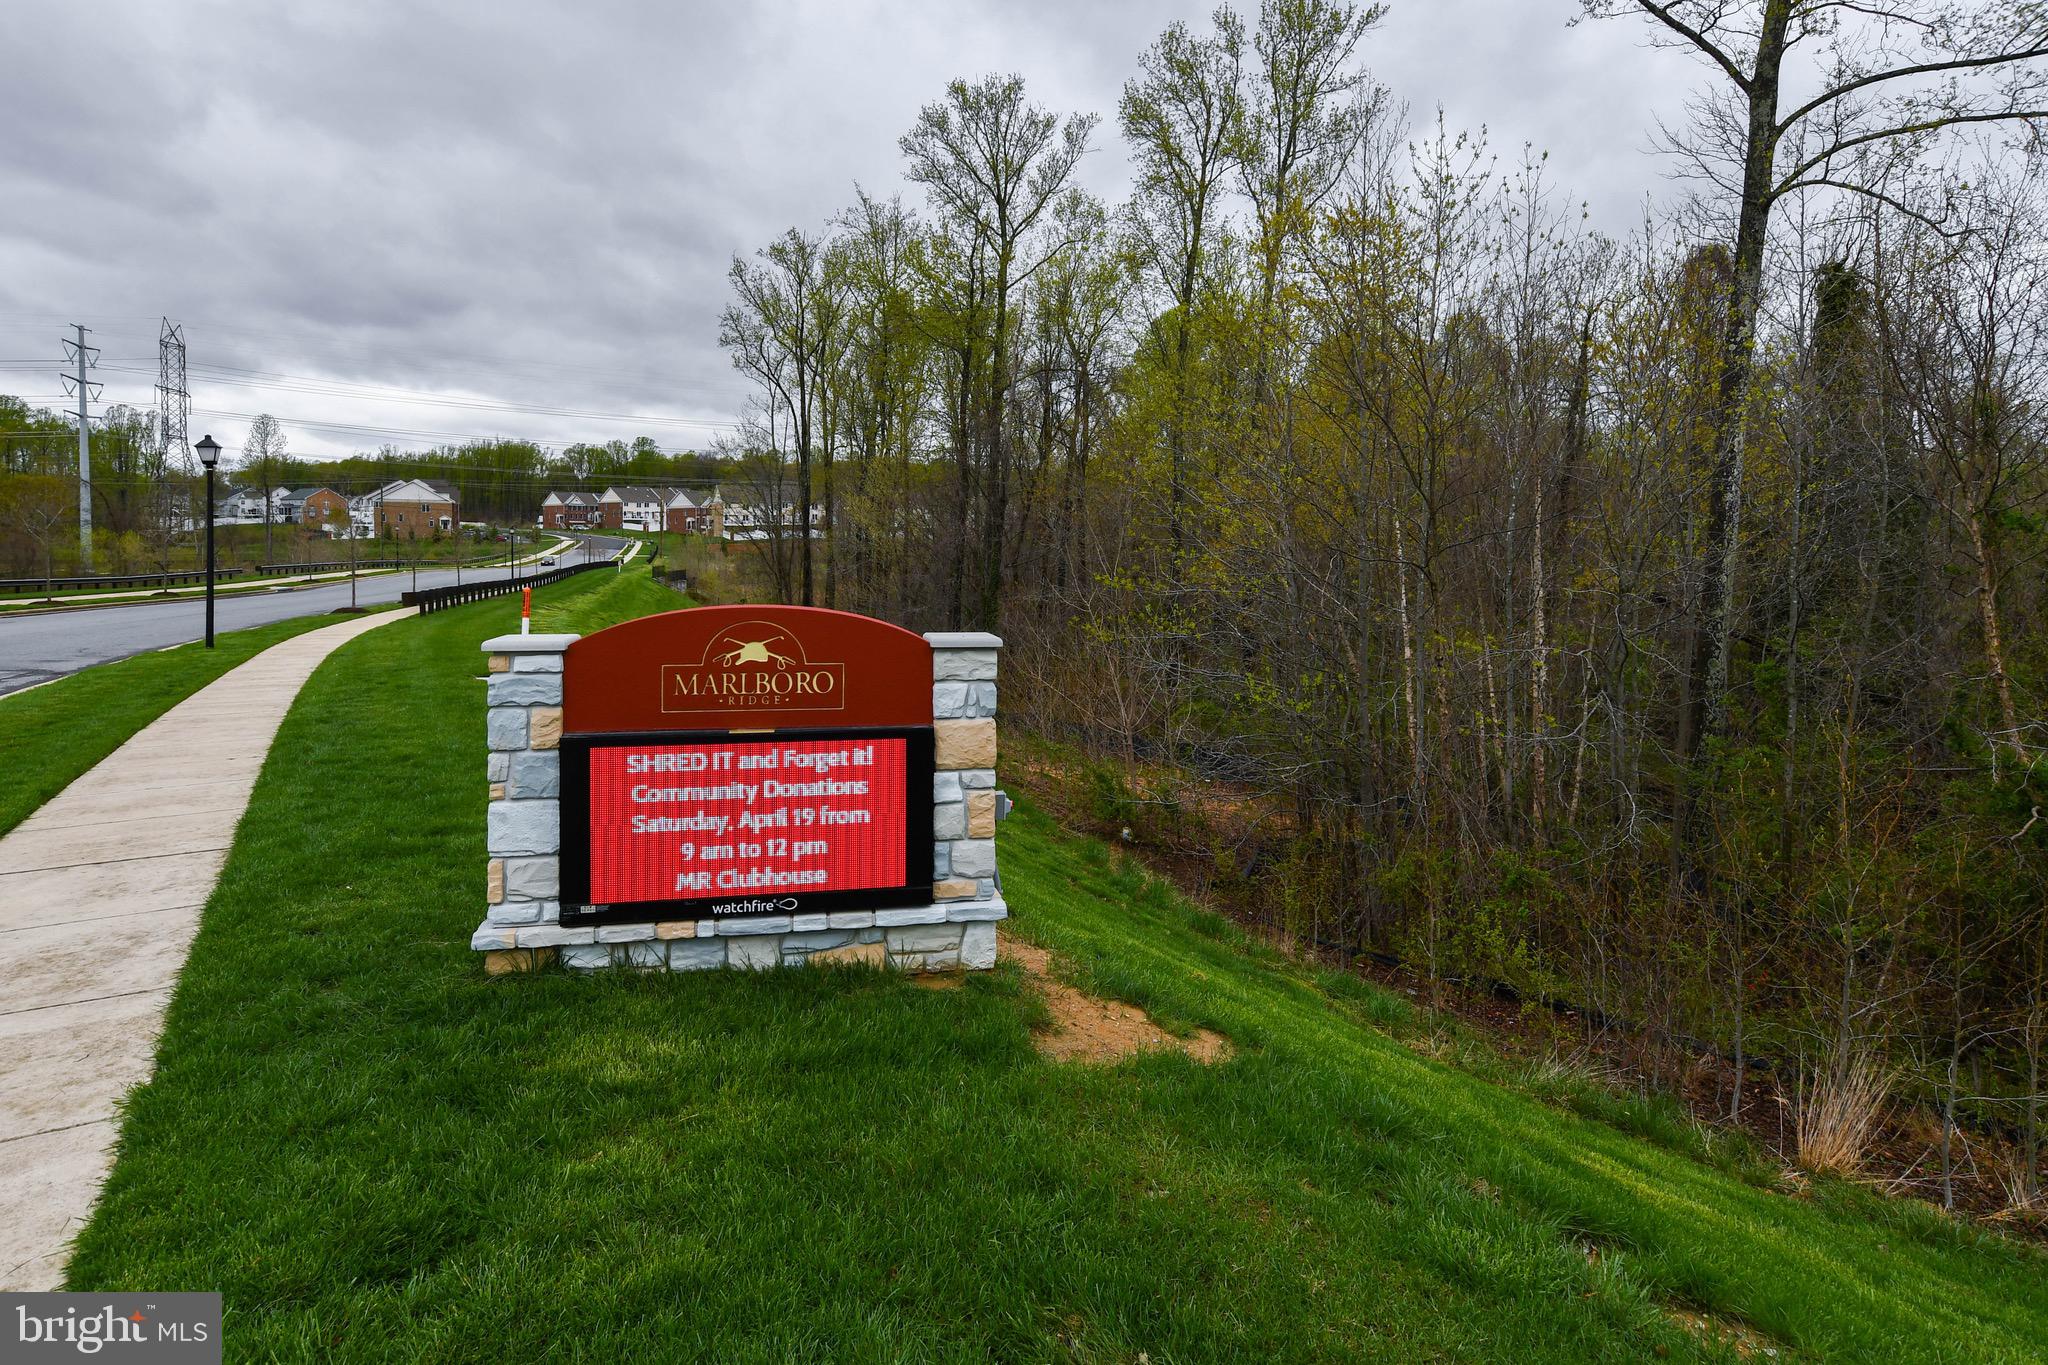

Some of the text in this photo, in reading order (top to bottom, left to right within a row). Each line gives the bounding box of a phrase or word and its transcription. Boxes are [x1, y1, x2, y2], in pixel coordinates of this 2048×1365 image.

[674, 671, 834, 696] MARLBORO
[728, 695, 781, 705] RIDGE
[627, 752, 708, 773] SHRED
[712, 751, 734, 770] IT
[738, 748, 778, 769] and
[784, 749, 849, 773] Forget
[631, 777, 869, 805] Community Donations
[738, 806, 788, 834] April
[793, 807, 816, 825] 19
[819, 805, 871, 825] from
[680, 838, 829, 861] 9 am to 12 pm
[675, 866, 829, 891] MR Clubhouse
[712, 900, 774, 914] watchfire
